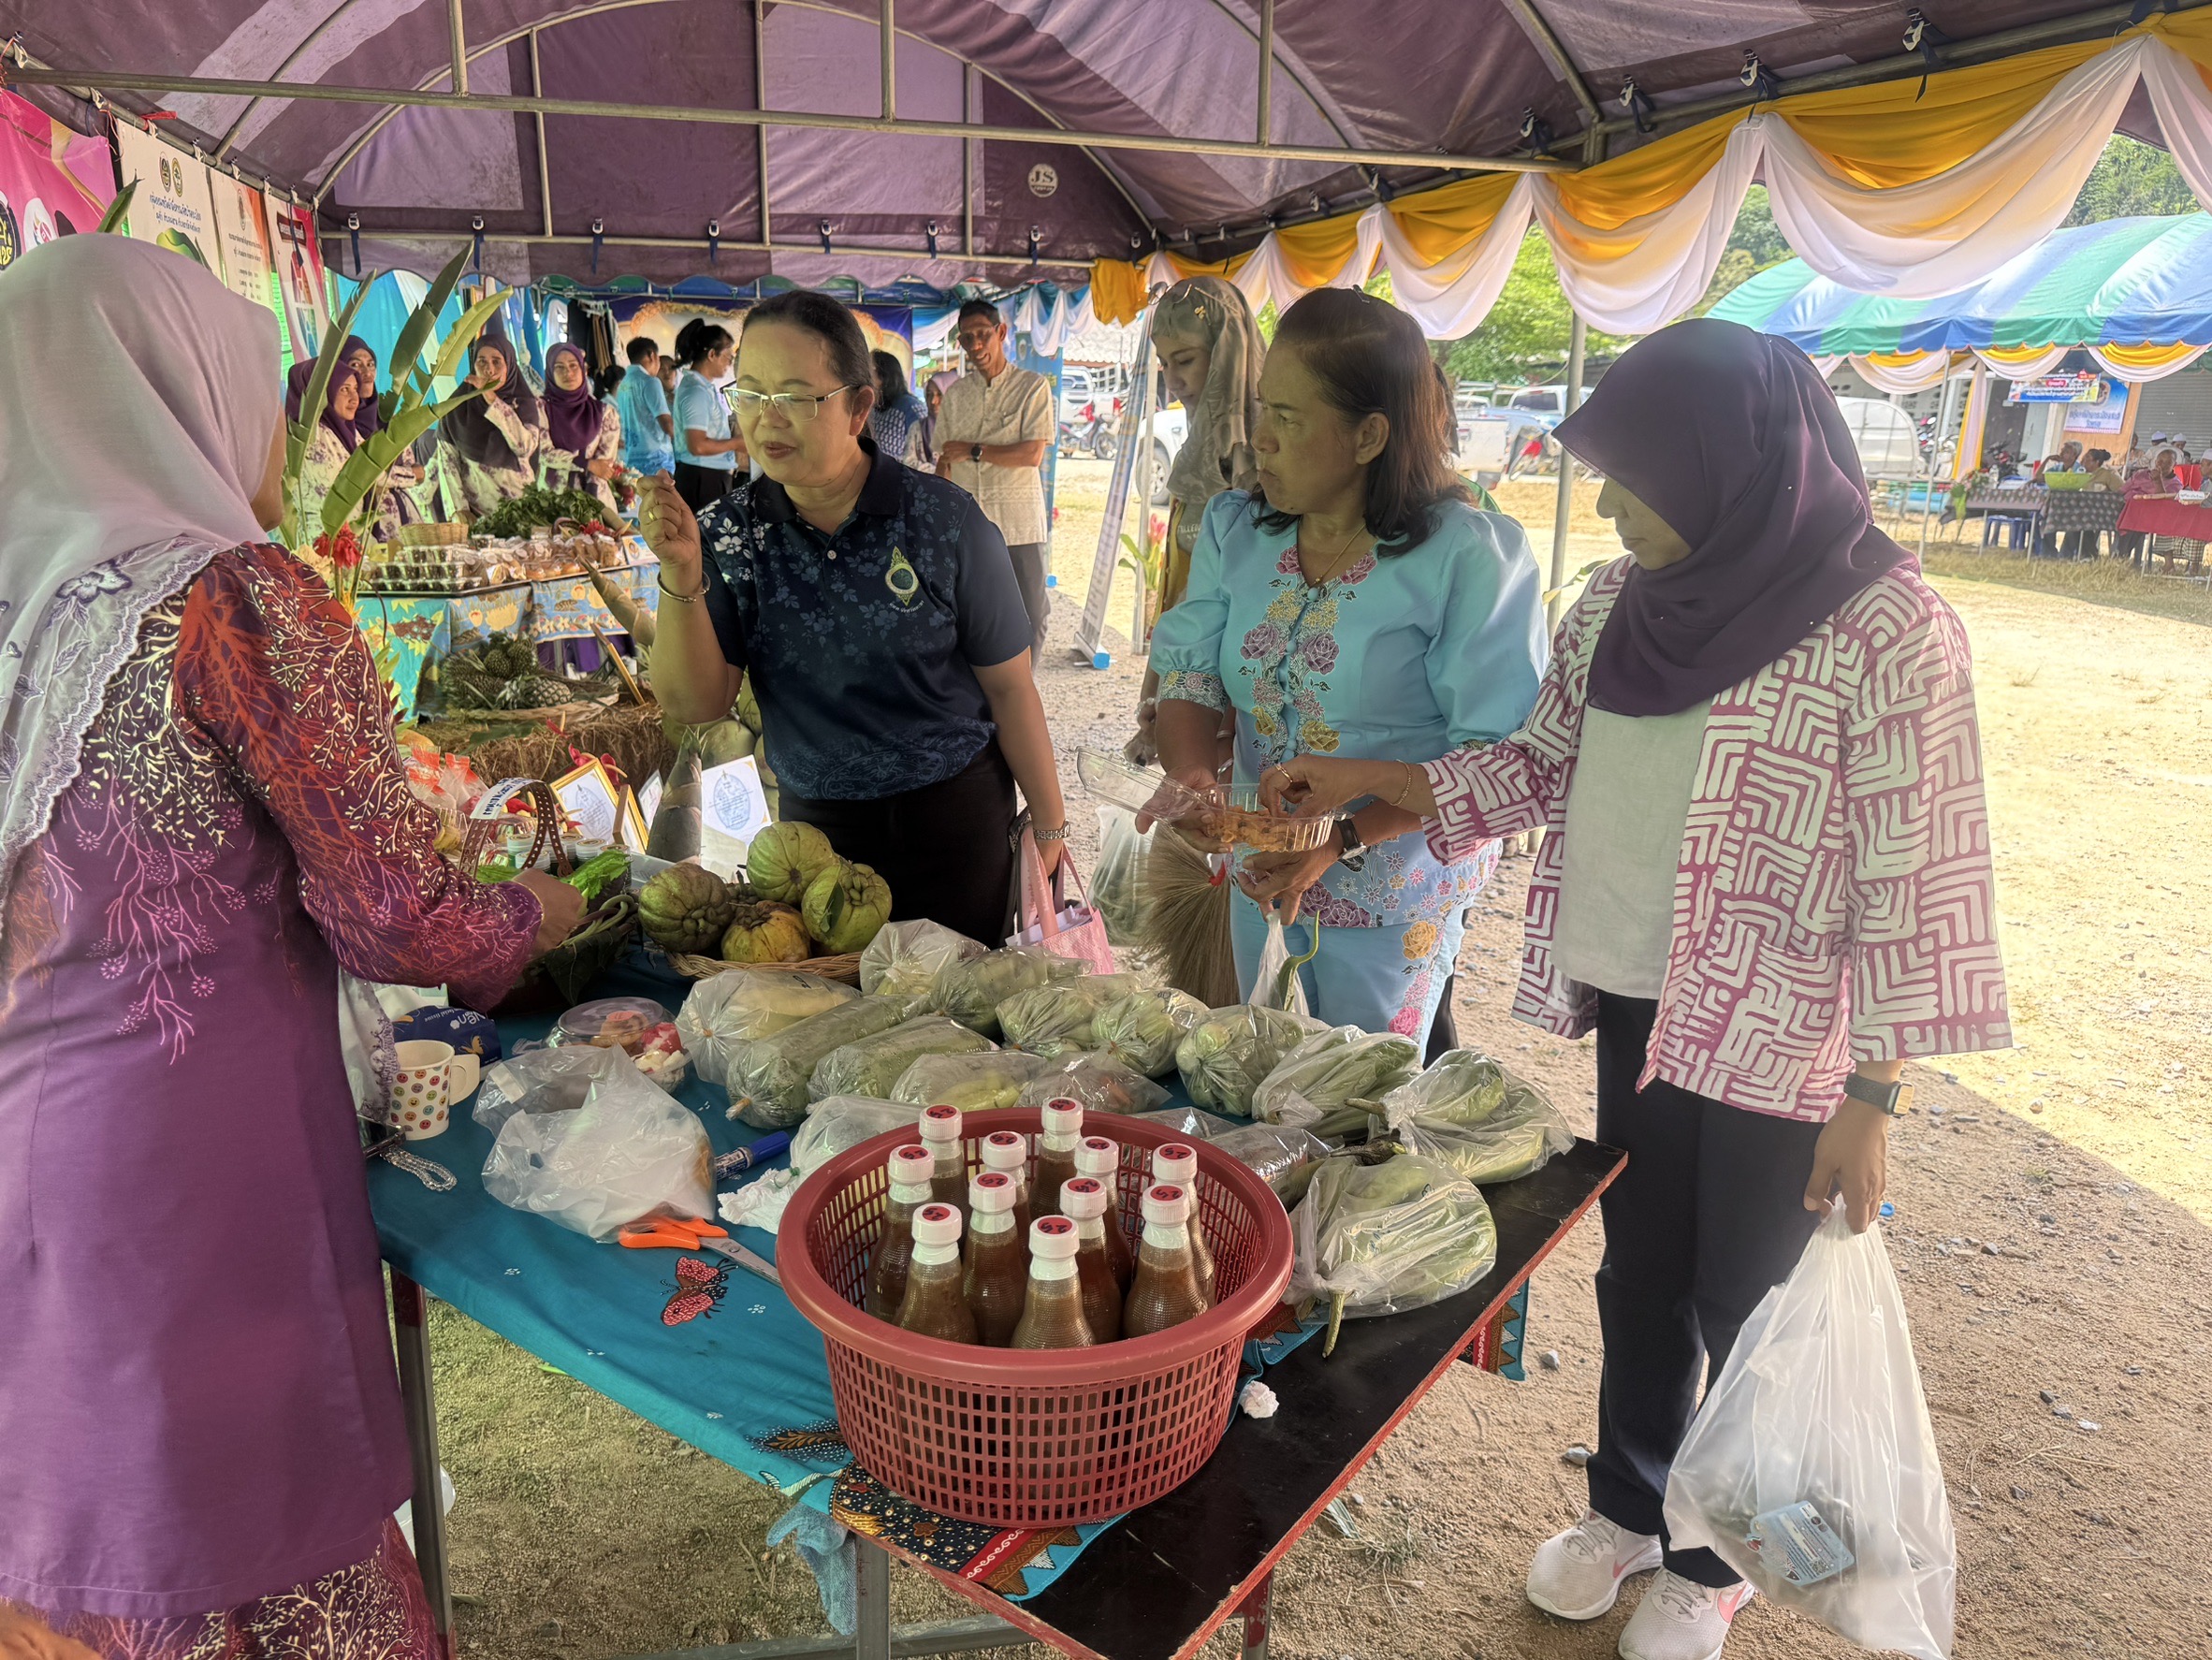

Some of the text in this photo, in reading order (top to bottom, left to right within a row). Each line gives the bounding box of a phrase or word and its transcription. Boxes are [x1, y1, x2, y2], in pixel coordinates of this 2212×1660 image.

[424, 1009, 455, 1023] facial tissue
[929, 1108, 954, 1119] 25
[991, 1133, 1016, 1144] 25
[903, 1149, 926, 1160] 25
[1164, 1147, 1188, 1159] 25
[981, 1175, 1006, 1186] 25
[1156, 1188, 1181, 1199] 25
[1041, 1222, 1068, 1234] 25
